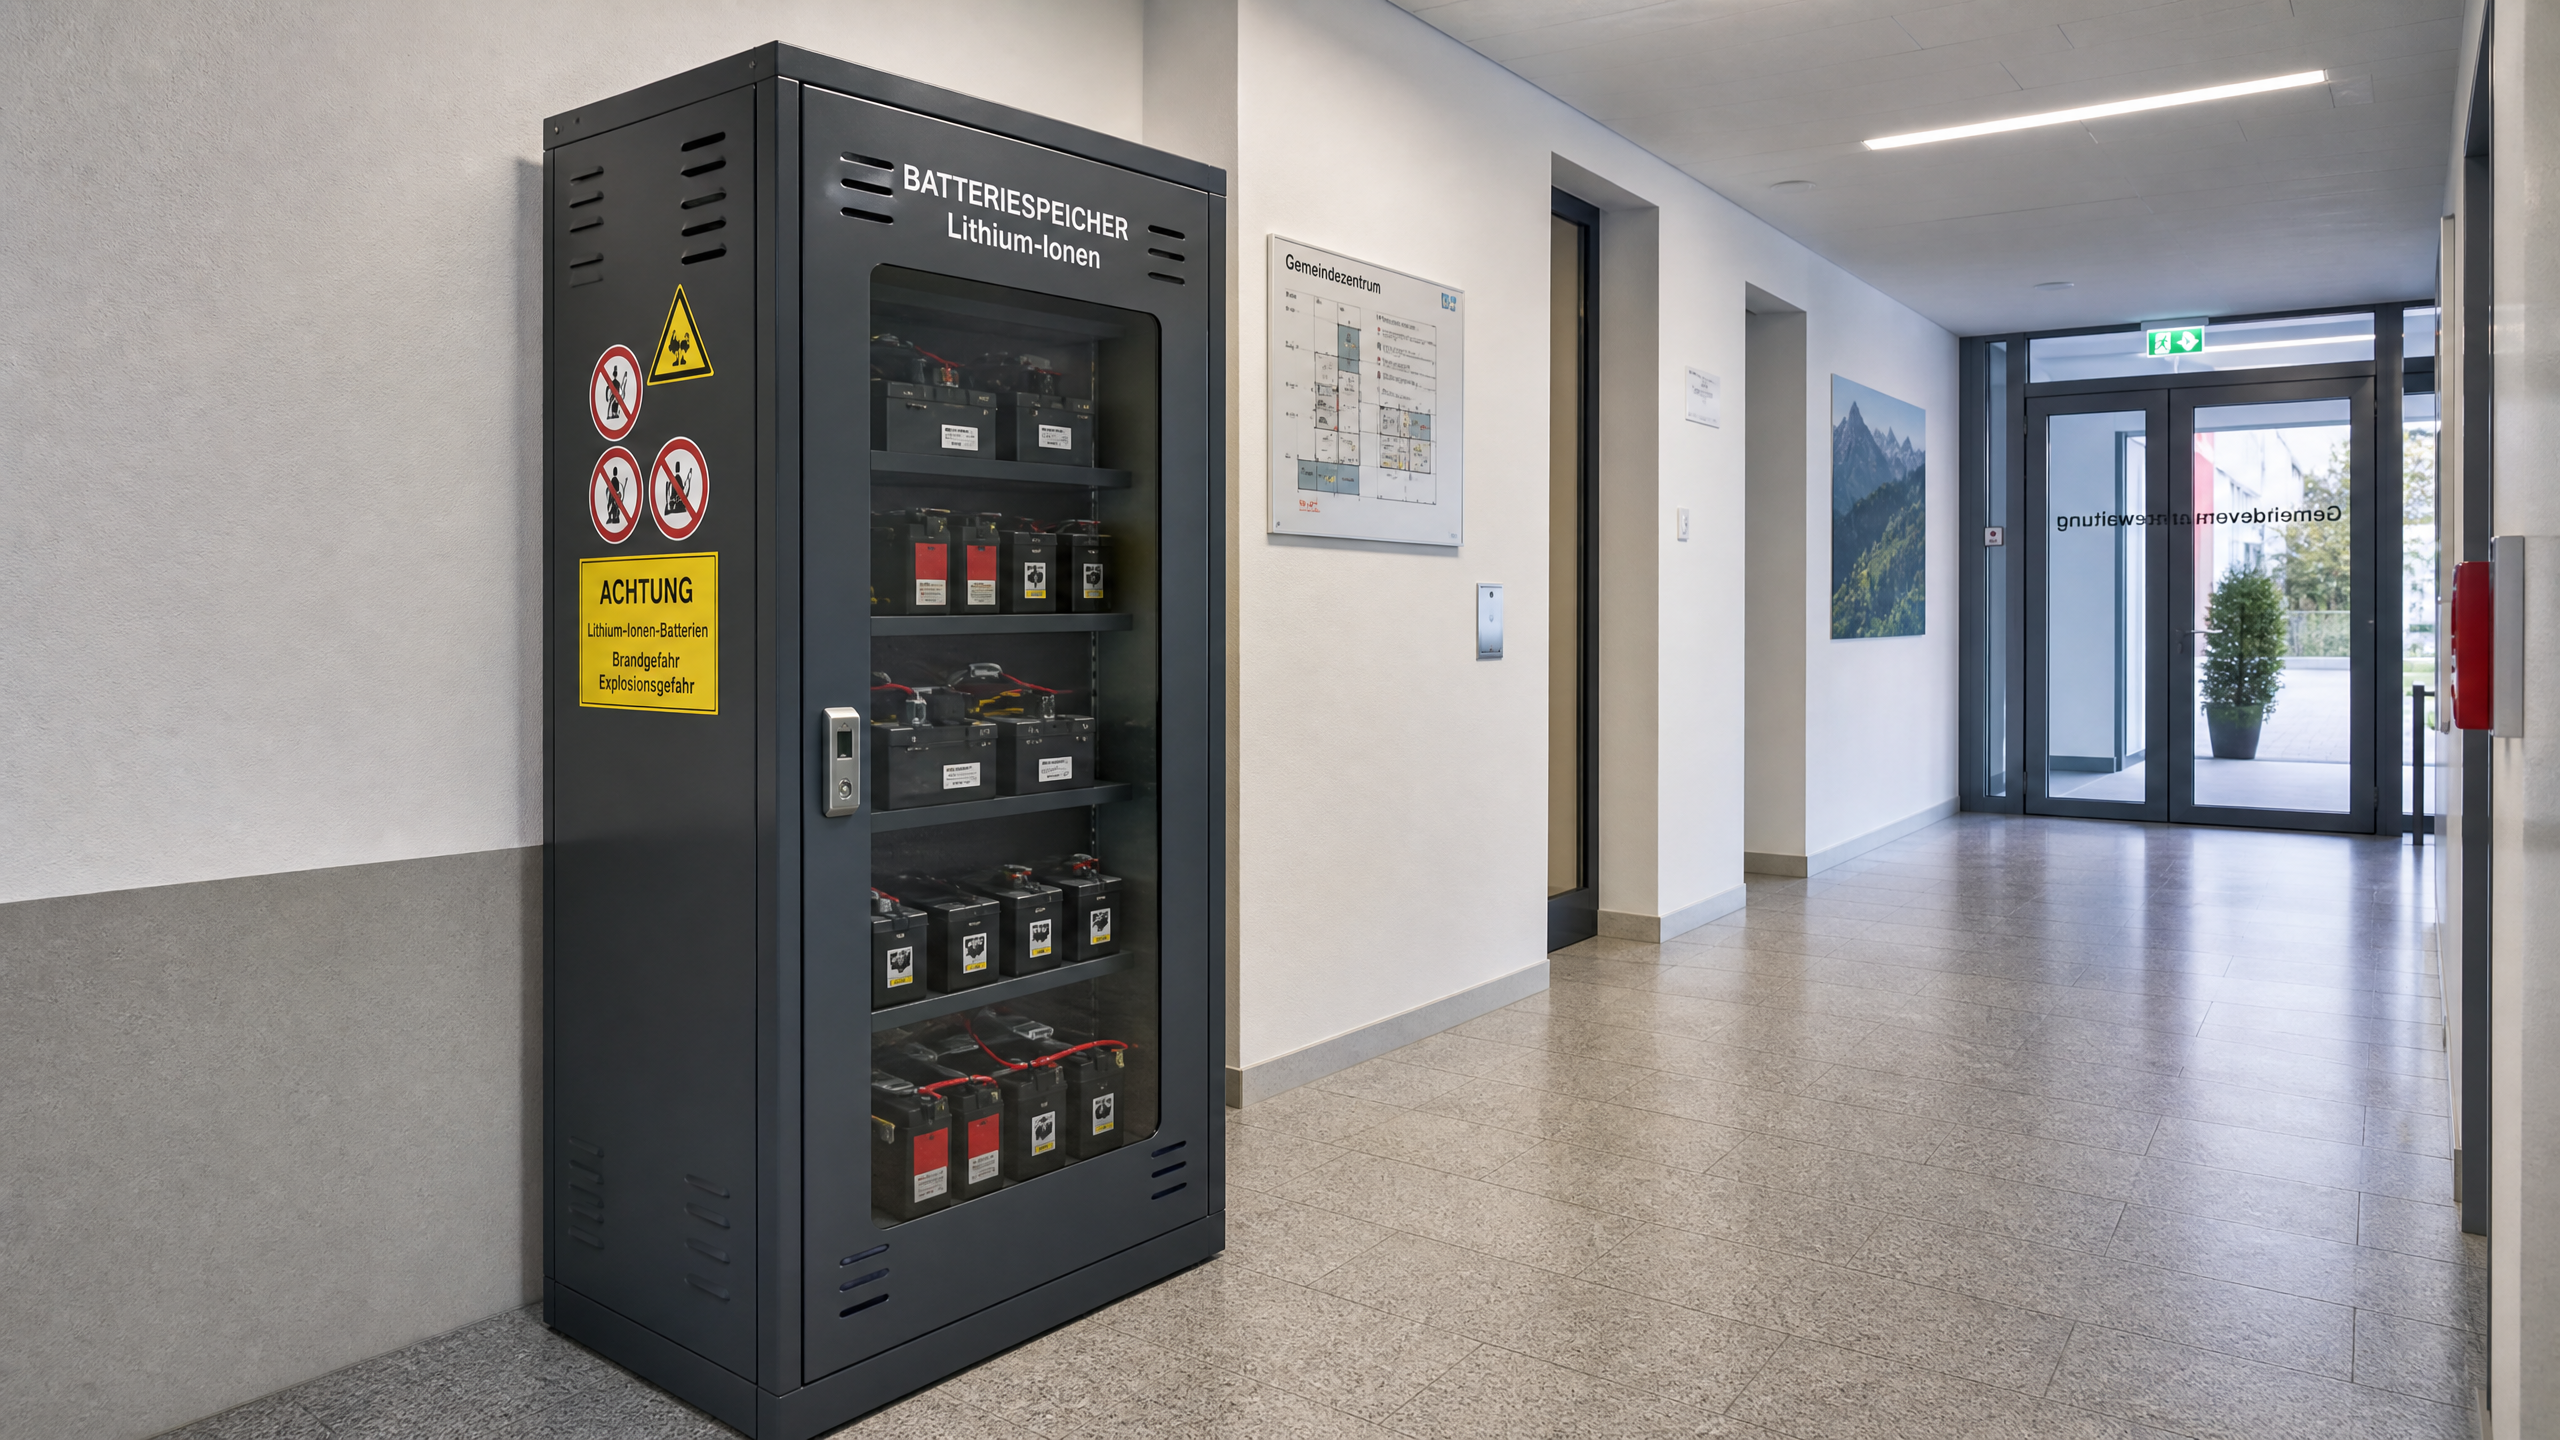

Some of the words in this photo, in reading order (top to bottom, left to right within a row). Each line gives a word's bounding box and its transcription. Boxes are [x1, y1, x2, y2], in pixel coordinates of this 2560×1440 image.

[903, 163, 1129, 241] BATTERIESPEICHER
[948, 212, 1100, 269] Lithium-Ionen
[1285, 253, 1381, 295] Gemeindezentrum
[600, 576, 693, 605] ACHTUNG
[587, 622, 709, 638] Lithium-Ionen-Batterien
[612, 651, 680, 672] Brandgefahr
[599, 674, 695, 697] Explosionsgefahr
